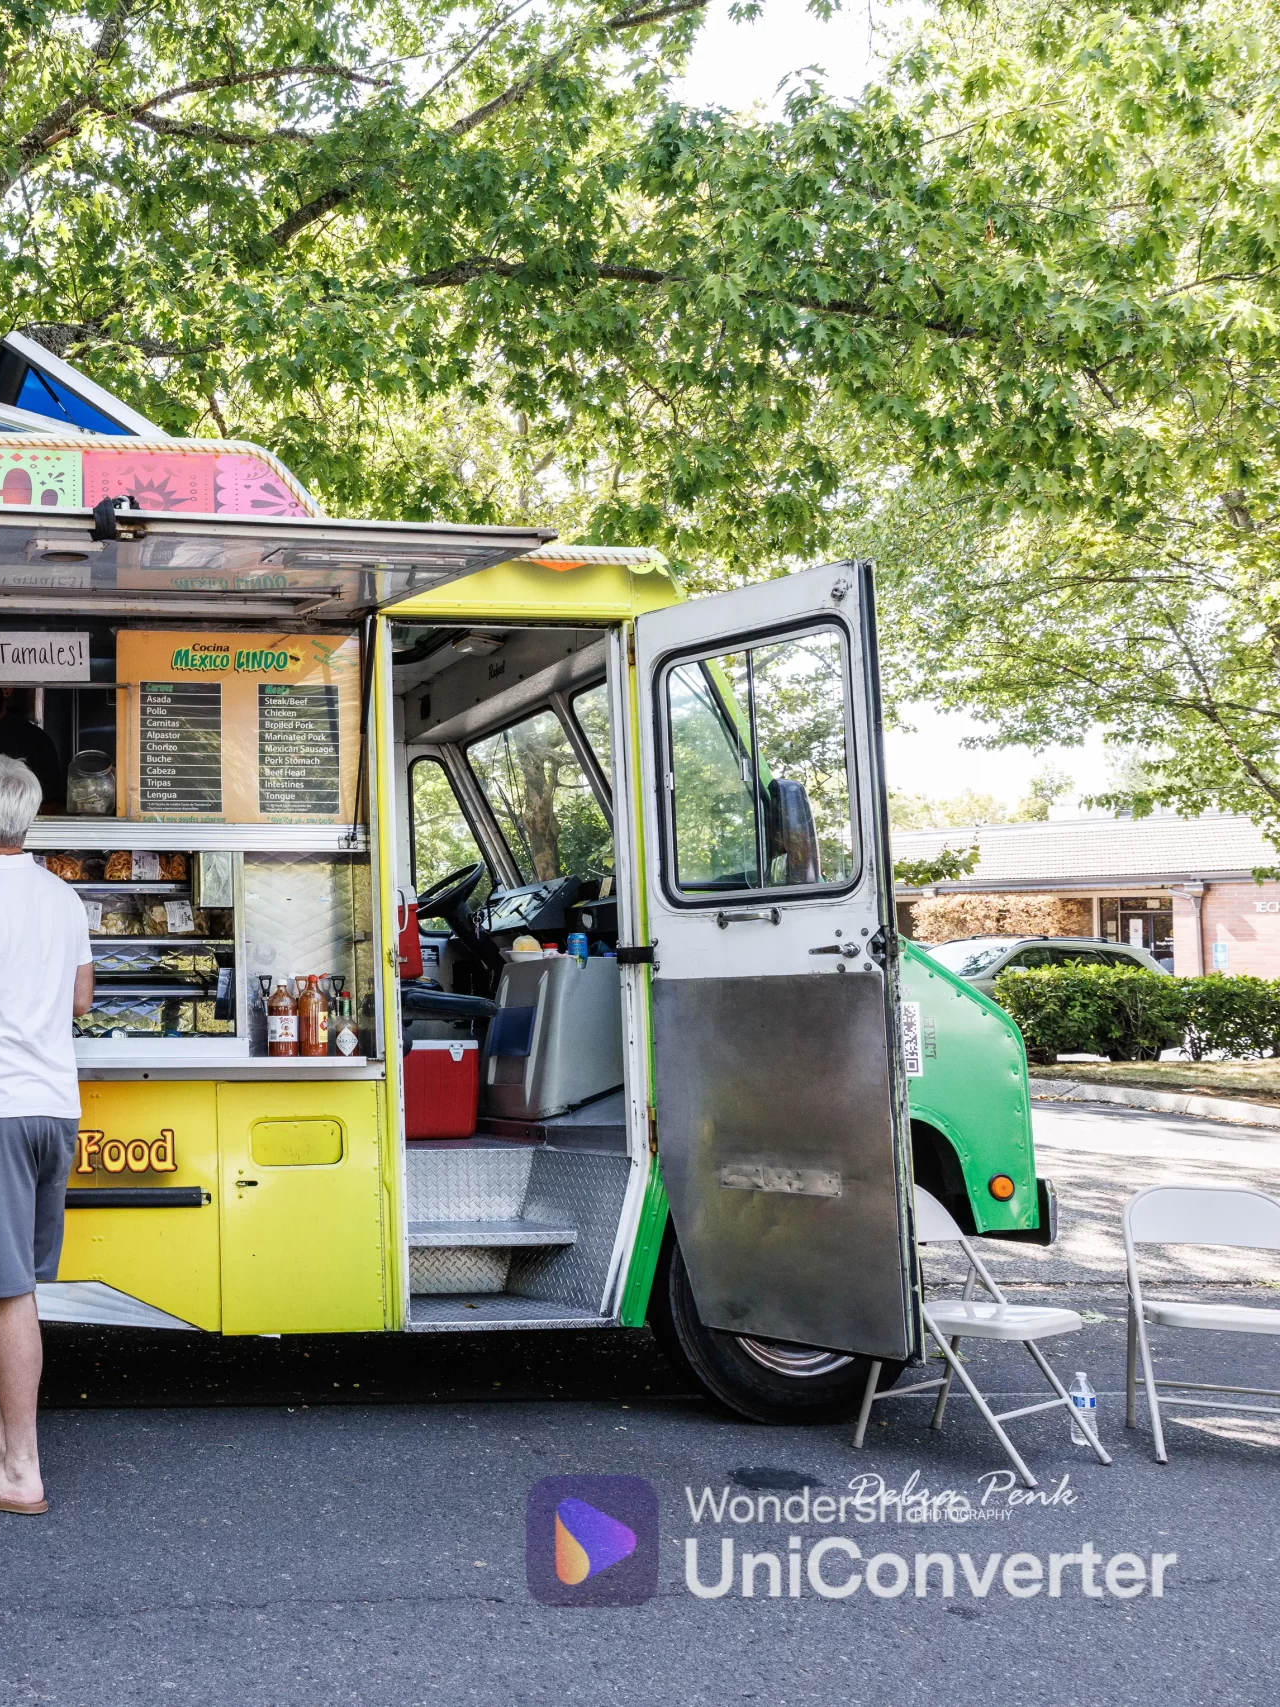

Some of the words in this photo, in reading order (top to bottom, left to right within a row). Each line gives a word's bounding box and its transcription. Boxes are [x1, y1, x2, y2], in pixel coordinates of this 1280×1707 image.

[192, 643, 230, 652] Cocina
[171, 647, 230, 671] MEXICO
[234, 649, 288, 672] LINDO
[146, 695, 171, 704] Asada
[265, 697, 308, 706] Steak/Beef
[146, 706, 167, 715] Pollo
[265, 708, 297, 717] Chicken
[146, 718, 180, 728] Carnitas
[265, 720, 293, 730] Broiled
[295, 720, 314, 730] Pork
[146, 730, 181, 740] Alpastor
[265, 732, 306, 742] Marinated
[307, 732, 326, 742] Pork
[146, 742, 177, 751] Chorizo
[265, 744, 298, 753] Mexican
[300, 745, 334, 755] Sausage
[146, 754, 172, 763] Buche
[265, 756, 285, 765] Pork
[286, 756, 320, 765] Stomach
[146, 766, 176, 775] Cabeza
[265, 767, 283, 777] Beef
[284, 767, 306, 777] Head
[146, 778, 171, 789] Tripas
[265, 779, 304, 789] Intestines
[146, 790, 177, 800] Lengua
[265, 791, 296, 802] Tongue
[76, 1128, 178, 1175] Food
